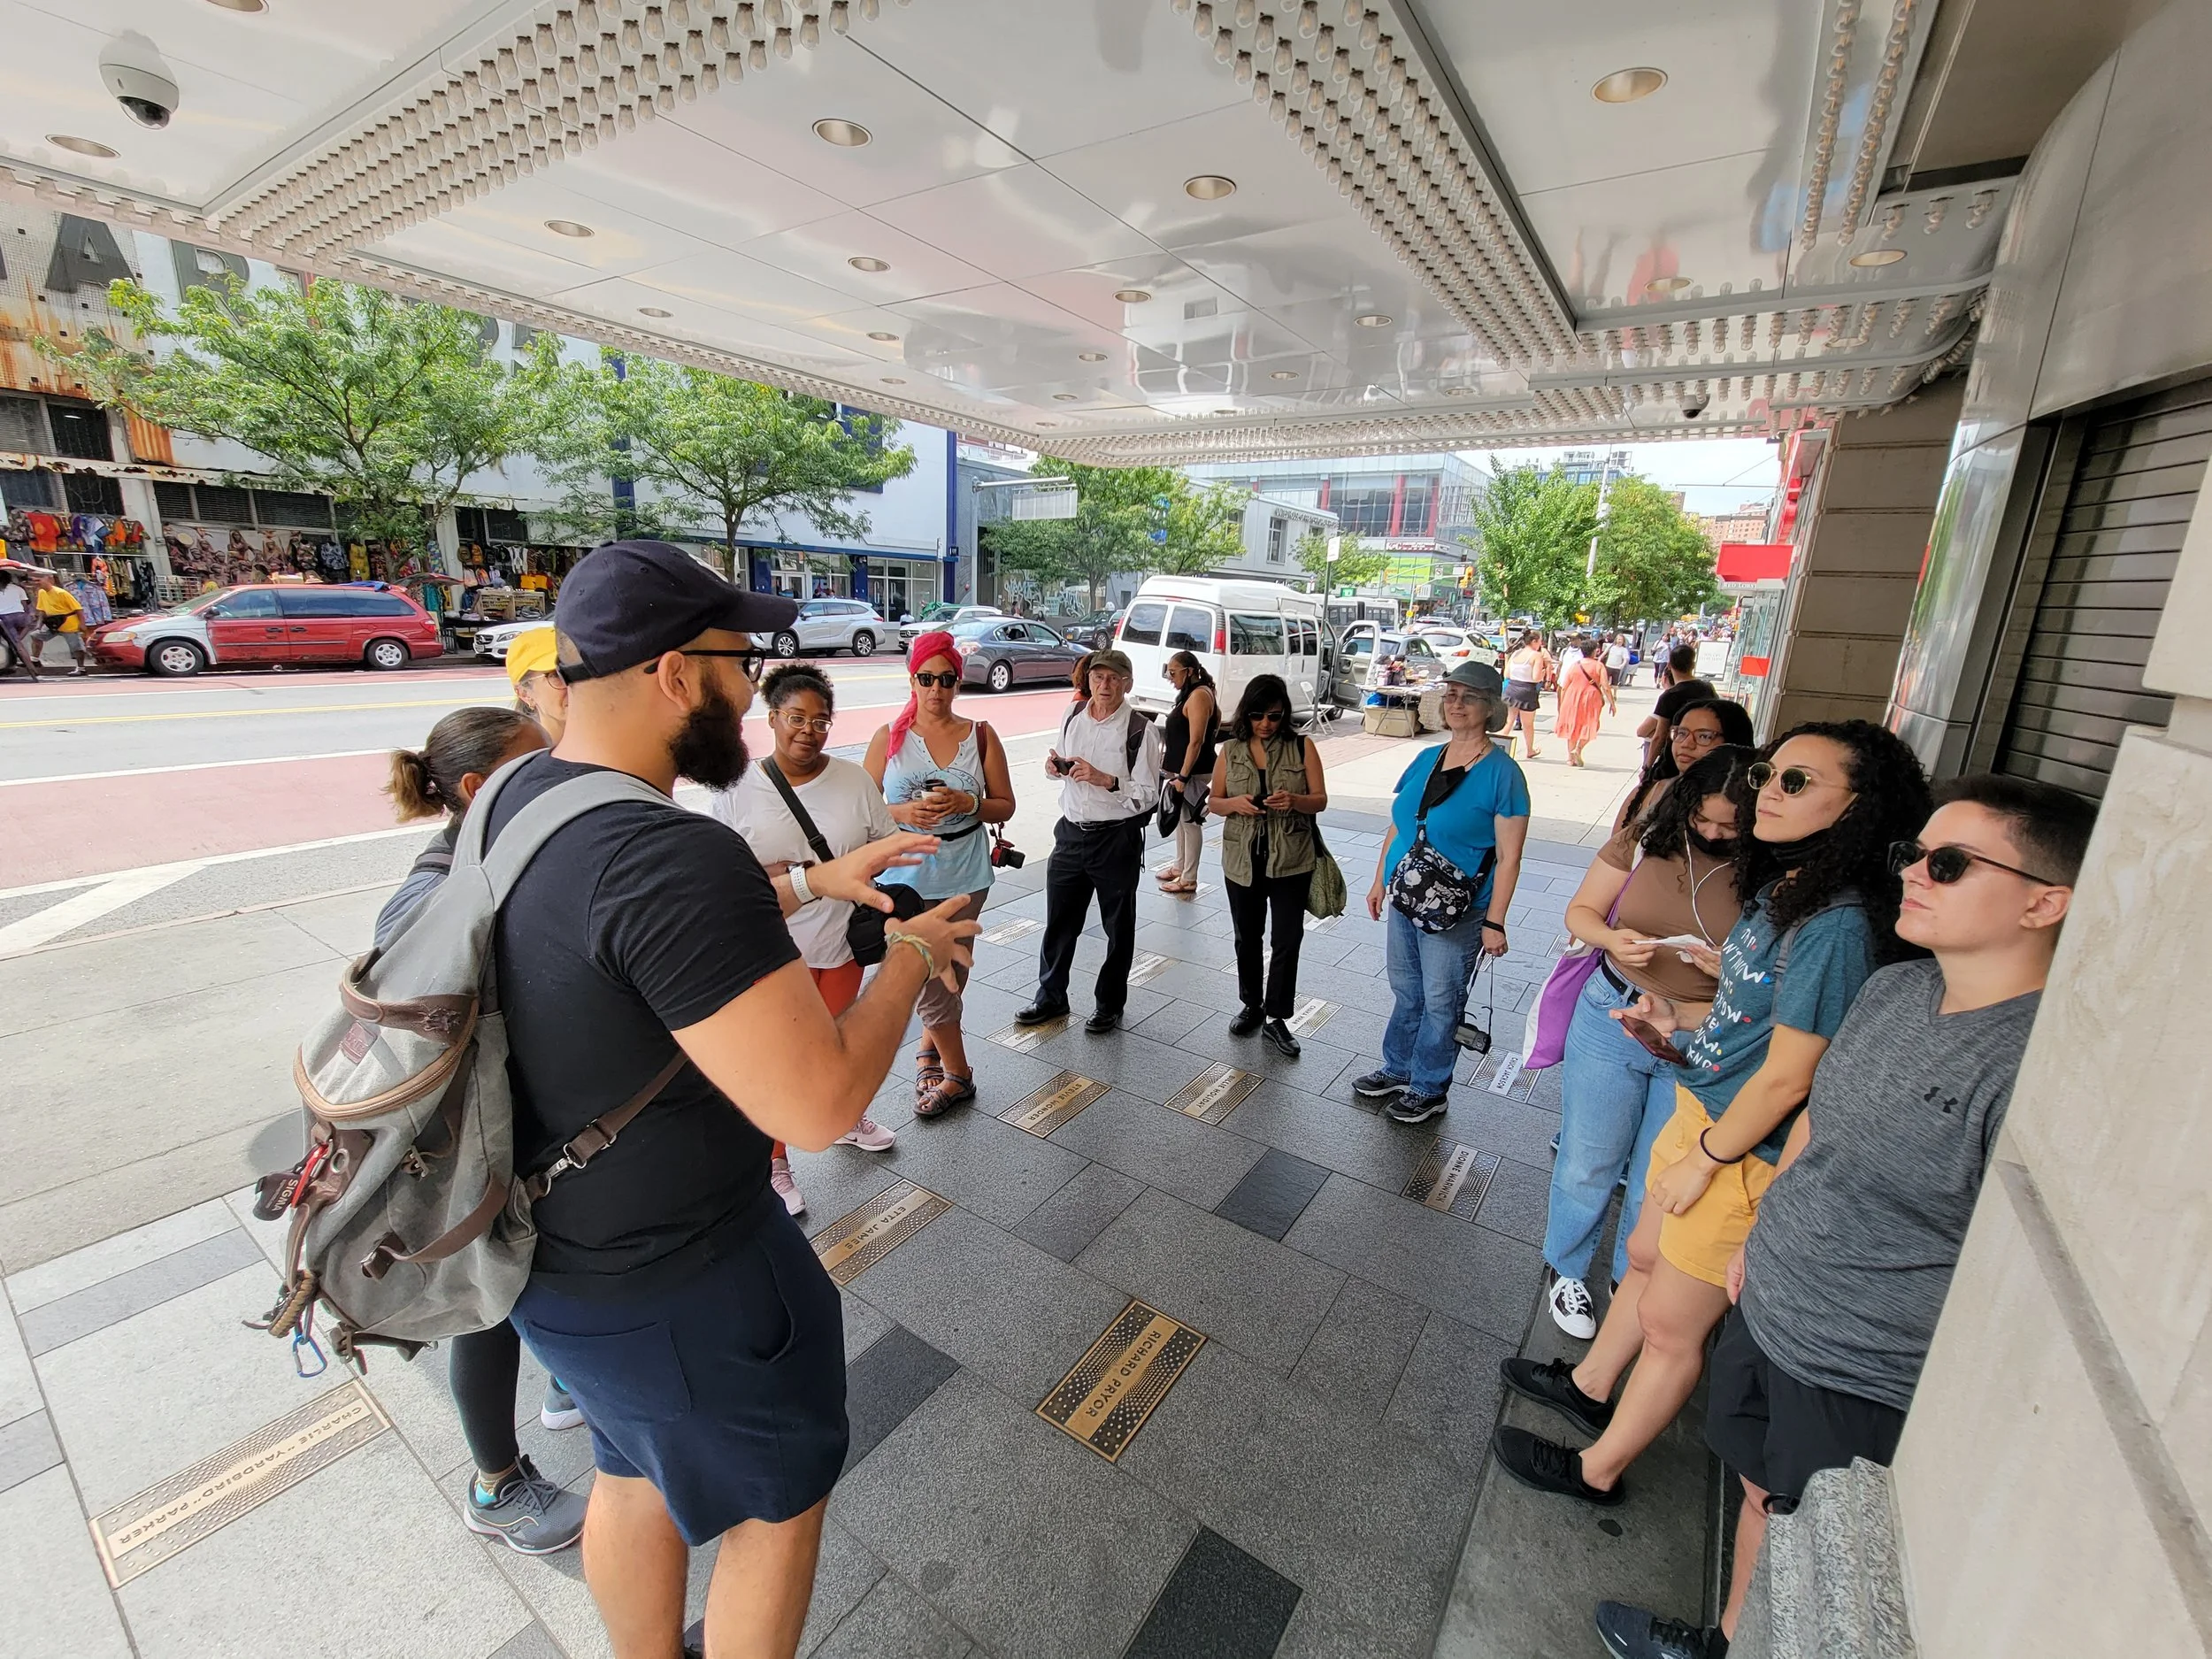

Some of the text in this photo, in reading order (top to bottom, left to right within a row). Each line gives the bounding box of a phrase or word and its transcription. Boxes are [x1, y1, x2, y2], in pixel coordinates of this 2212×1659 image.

[1195, 1074, 1235, 1110] BILLIE HOLIDAY
[1496, 1056, 1518, 1089] CHUCK JACKSON
[1027, 1083, 1082, 1121] STEVIE WONDER
[271, 1179, 299, 1211] SIGMA
[1435, 1150, 1470, 1203] DIONNE WARWICK
[844, 1206, 907, 1249] ETTA JAMES
[1085, 1330, 1162, 1417] RICHARD PRYOR
[298, 1405, 363, 1445] CHARLIE
[118, 1500, 189, 1545] PARKER
